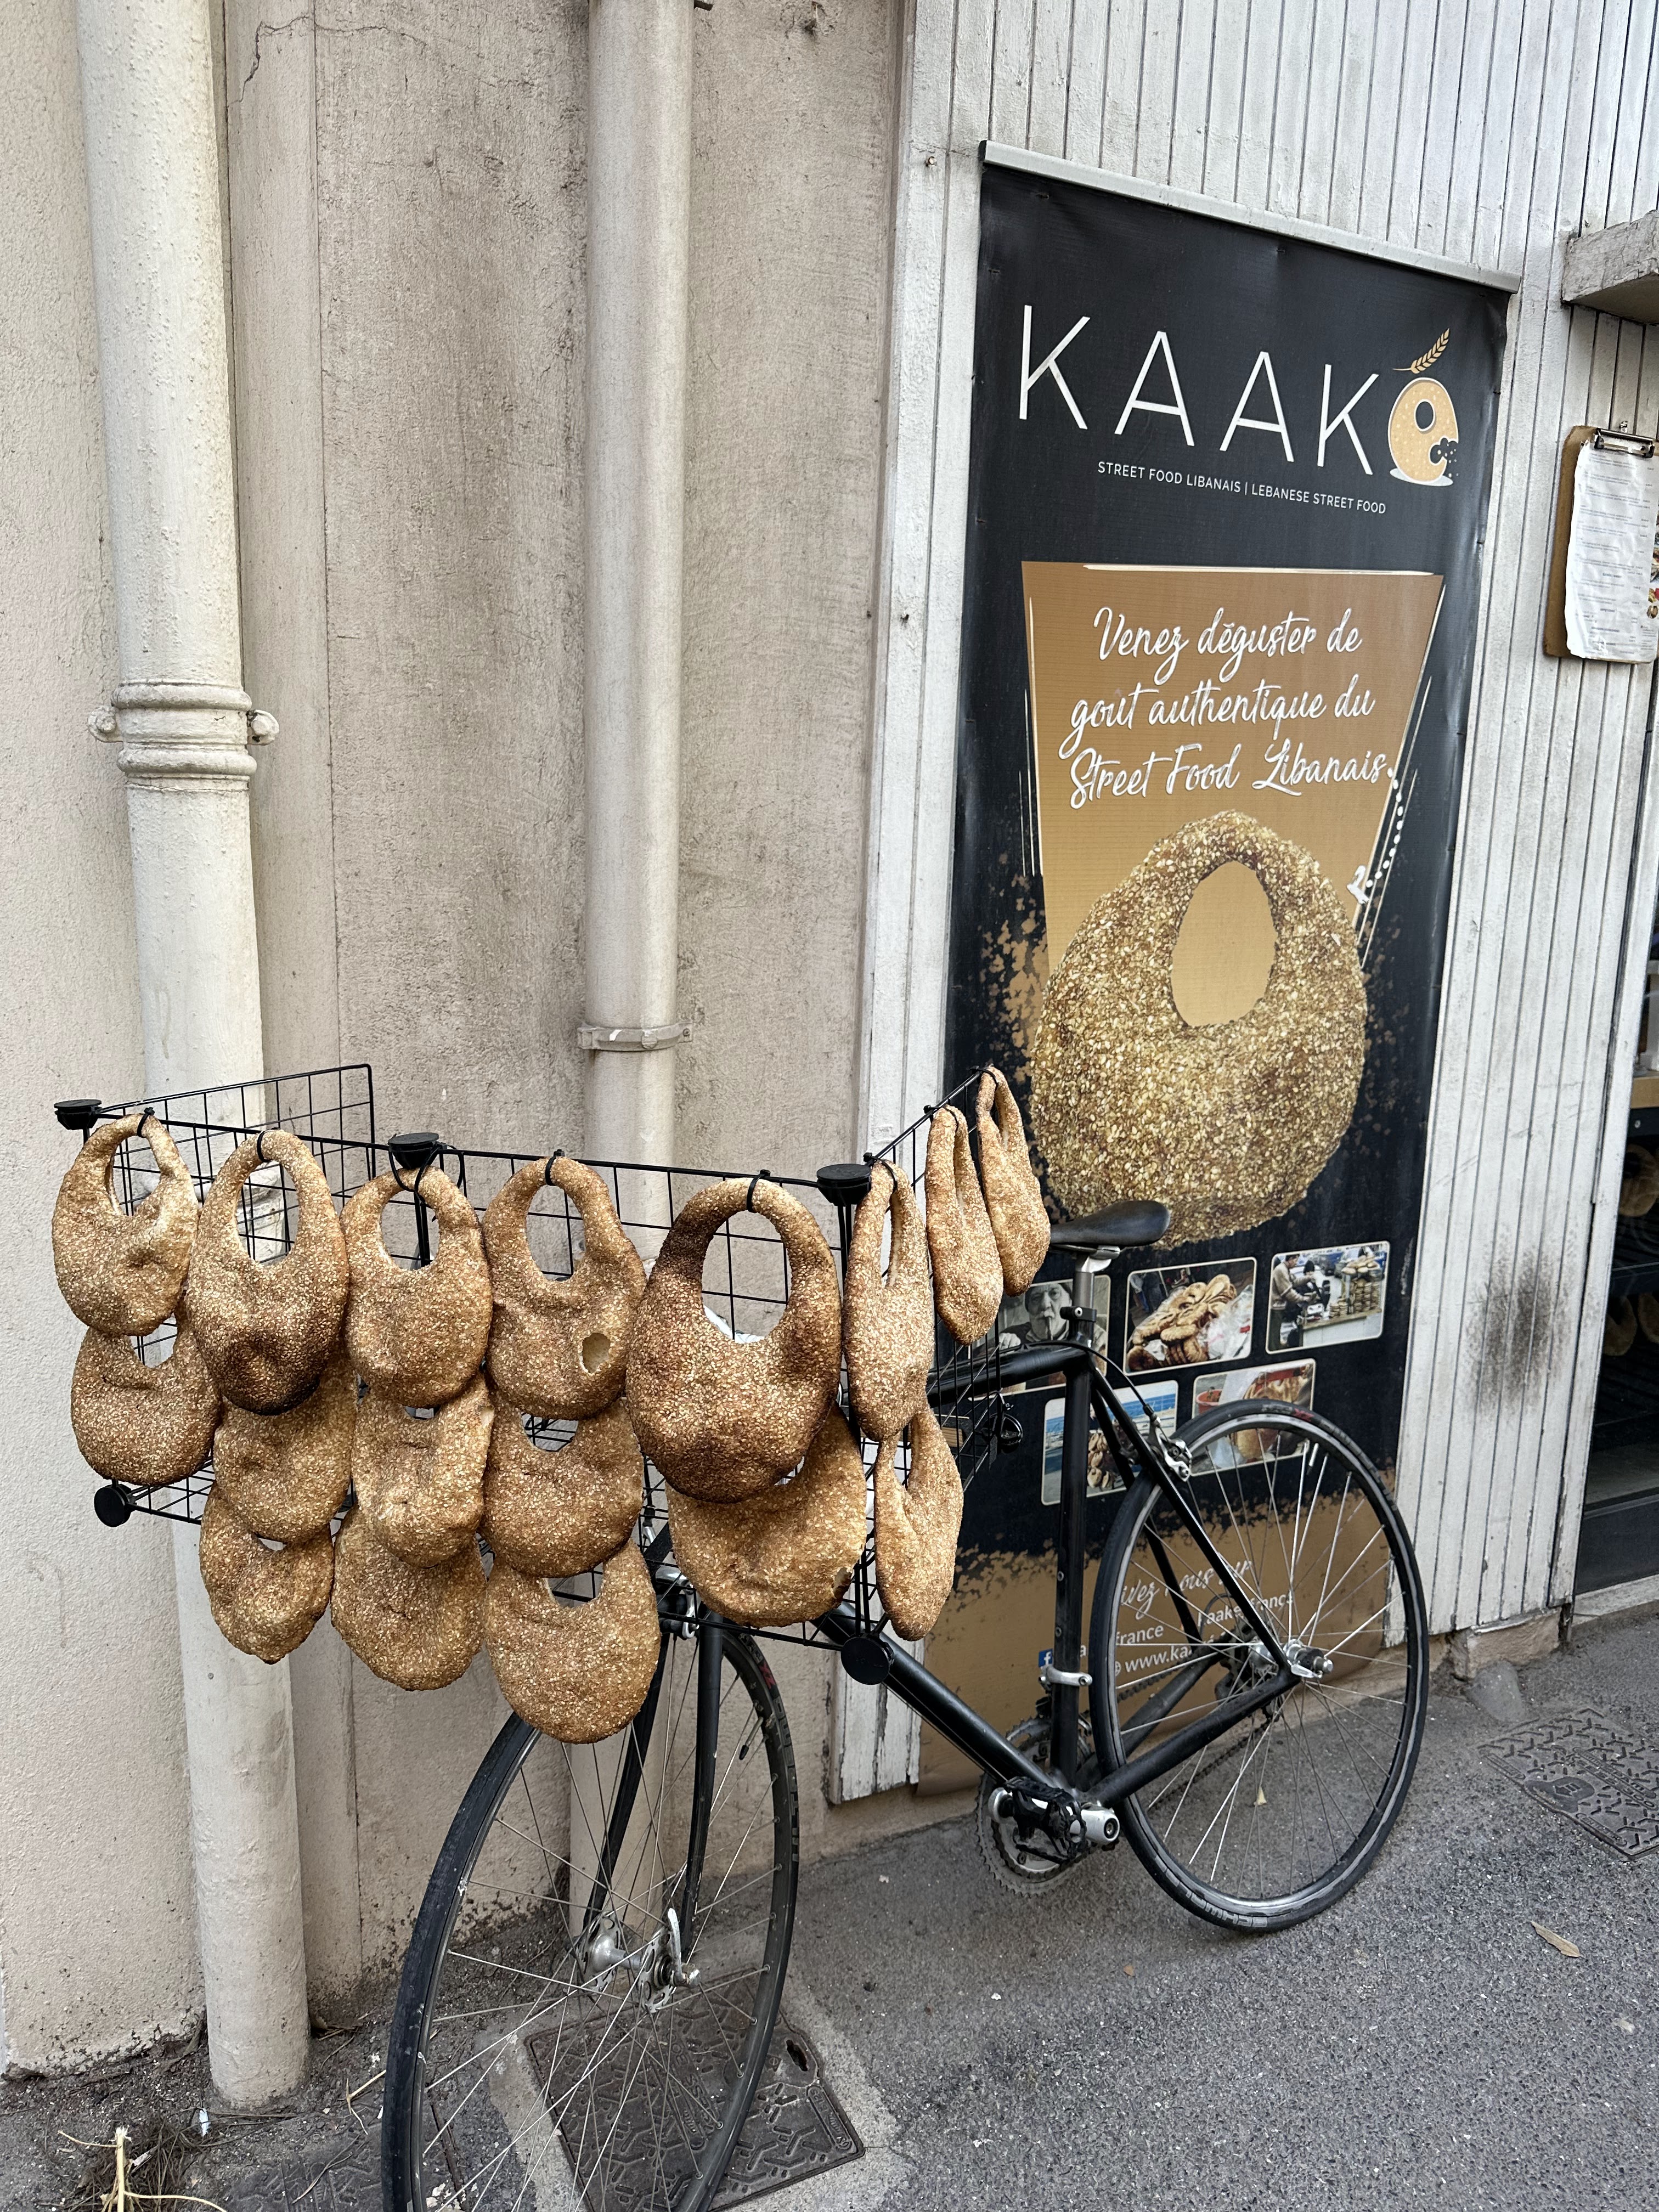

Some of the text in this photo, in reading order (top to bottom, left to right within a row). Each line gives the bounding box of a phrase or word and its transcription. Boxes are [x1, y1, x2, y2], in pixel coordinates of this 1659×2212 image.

[1097, 461, 1146, 480] STREET
[1148, 468, 1183, 484] FOOD
[1186, 473, 1241, 493] LIBANAIS
[1251, 483, 1311, 504] LEBANESE
[1312, 493, 1355, 510] STREET
[1356, 499, 1386, 515] FOOD
[1093, 606, 1190, 686] Venez
[1326, 607, 1363, 654] de
[1148, 678, 1328, 741] authentique
[1334, 673, 1375, 719] du
[1069, 747, 1173, 810] Street
[1166, 743, 1243, 795] Food
